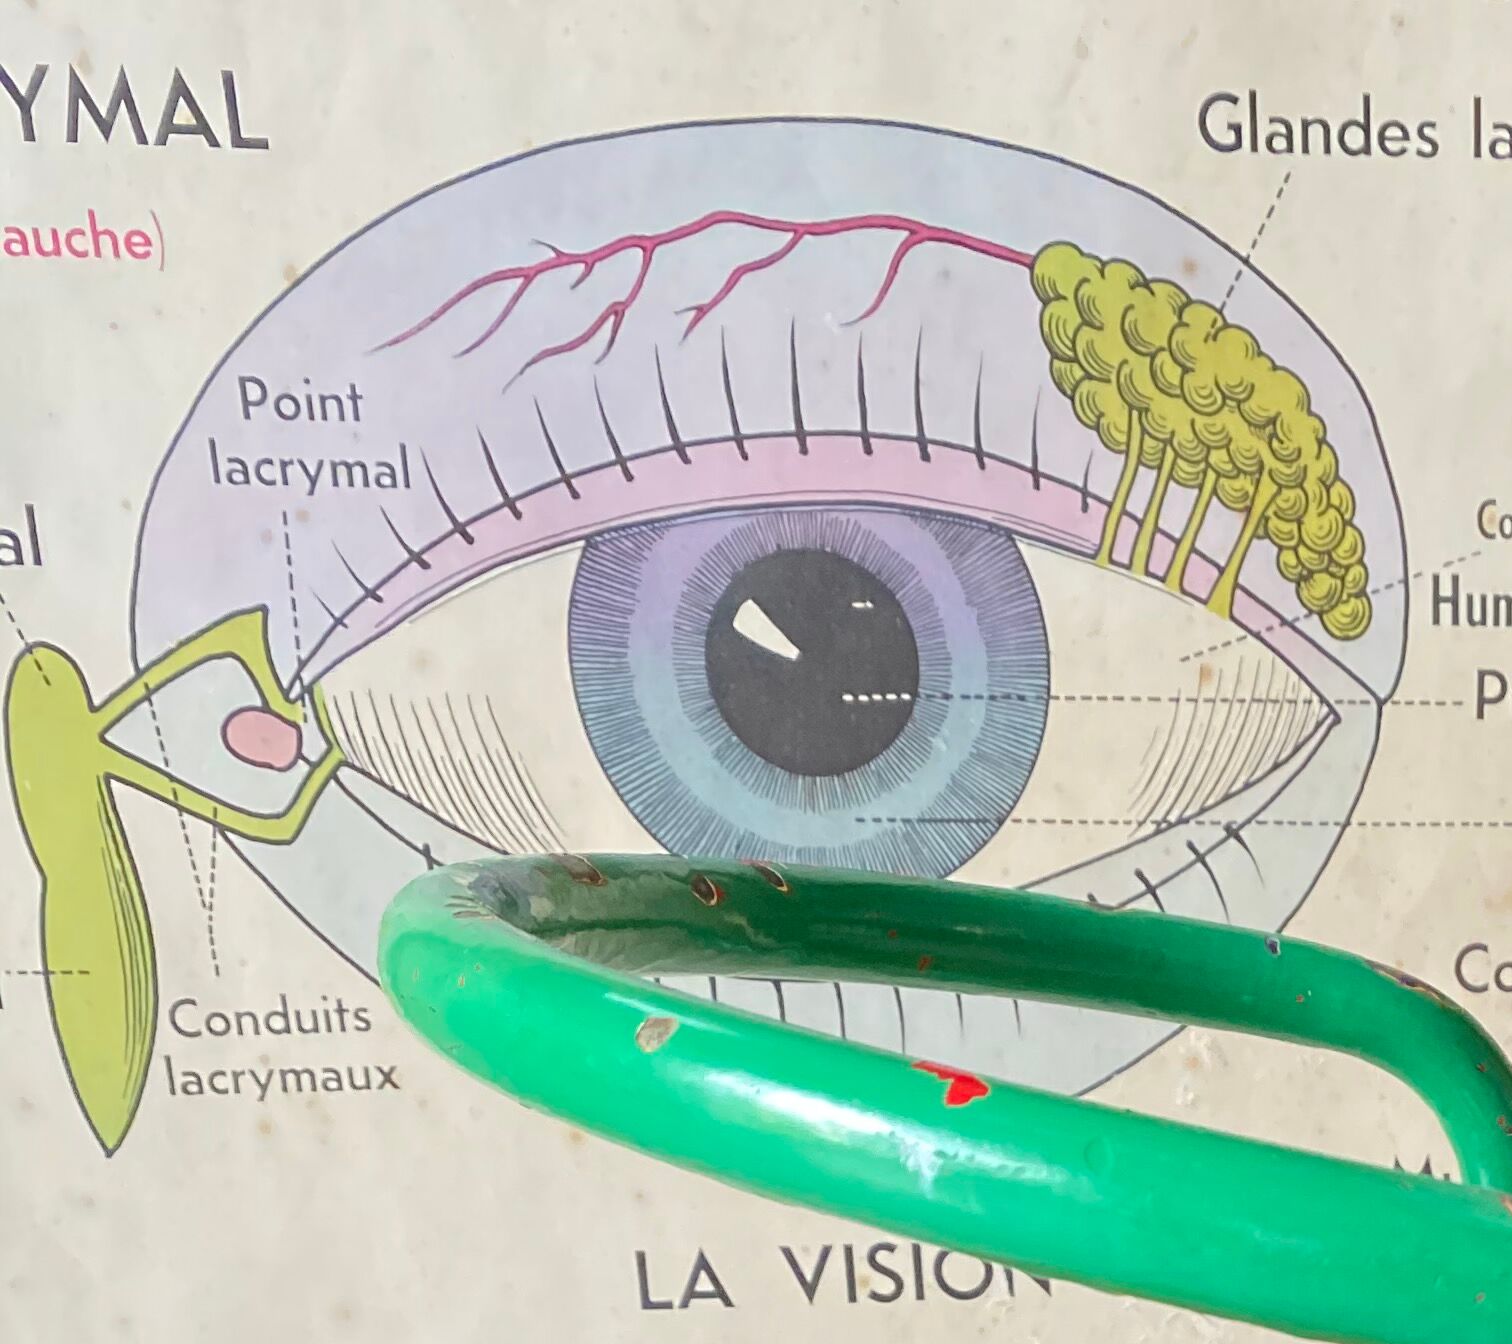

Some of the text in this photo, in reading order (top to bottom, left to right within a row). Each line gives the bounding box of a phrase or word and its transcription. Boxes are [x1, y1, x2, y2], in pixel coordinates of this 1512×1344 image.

[0, 63, 270, 151] YMAL
[1198, 88, 1440, 159] Glandes
[2, 207, 165, 272] auche)
[237, 375, 364, 423] Point
[208, 437, 411, 497] lacrymal
[168, 993, 372, 1039] Conduits
[163, 1054, 401, 1102] lacrymaux
[635, 1247, 736, 1311] LA
